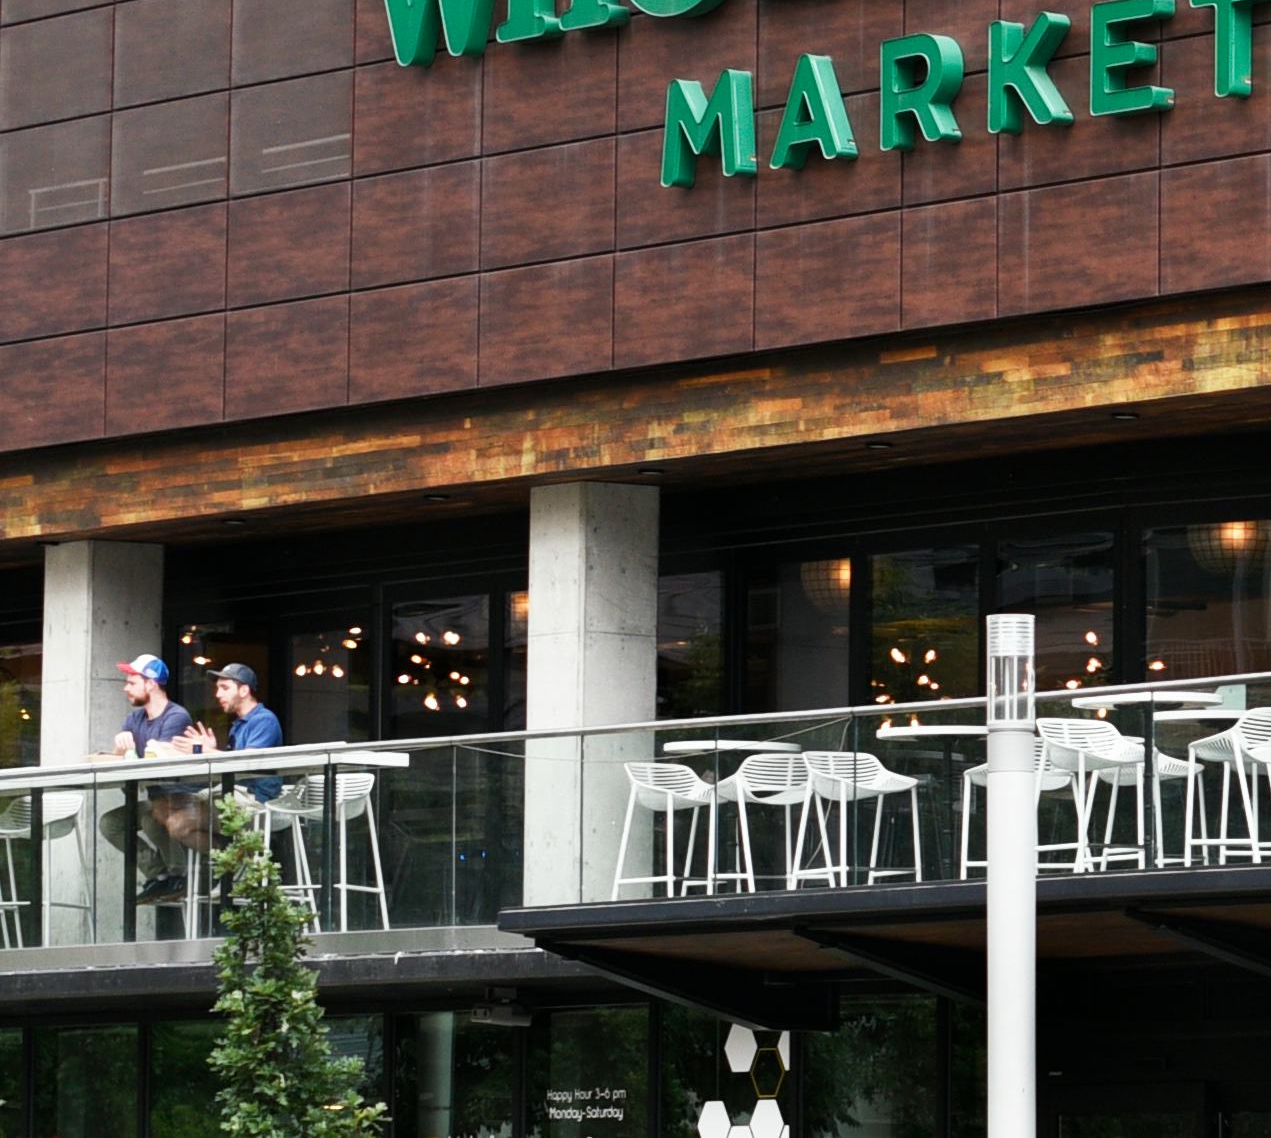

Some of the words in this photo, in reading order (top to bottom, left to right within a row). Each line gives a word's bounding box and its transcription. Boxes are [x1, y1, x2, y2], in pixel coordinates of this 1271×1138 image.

[547, 1089, 573, 1103] Happy
[575, 1089, 592, 1100] Hour
[595, 1088, 610, 1100] 3-6
[612, 1089, 626, 1102] pm
[549, 1106, 624, 1122] Monday-Saturday
